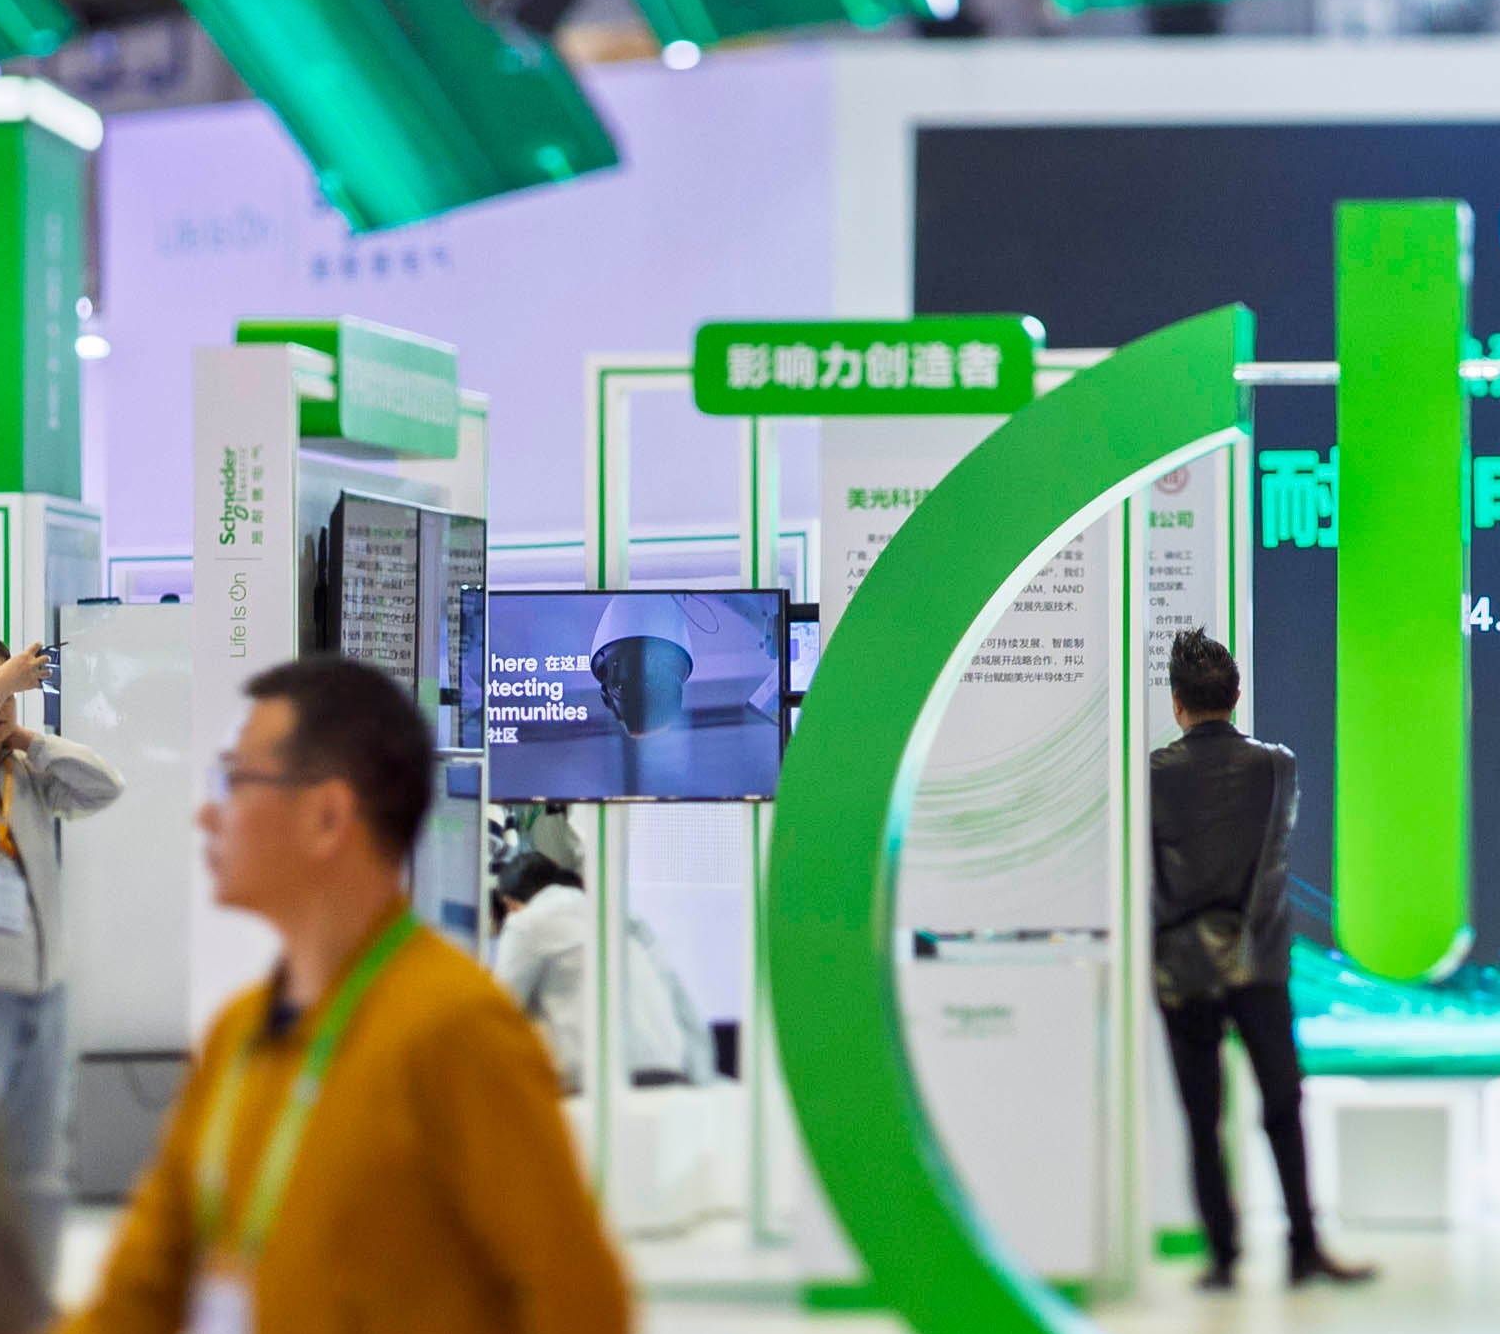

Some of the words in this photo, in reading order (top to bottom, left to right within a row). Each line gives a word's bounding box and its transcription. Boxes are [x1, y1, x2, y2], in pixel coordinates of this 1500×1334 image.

[726, 340, 1002, 389] 影响力创造者
[219, 446, 243, 546] Schneider
[228, 572, 246, 602] On
[230, 606, 246, 620] Is
[230, 630, 246, 658] Life
[491, 653, 538, 672] here
[545, 655, 591, 672] 在这里
[487, 701, 588, 721] mmunities
